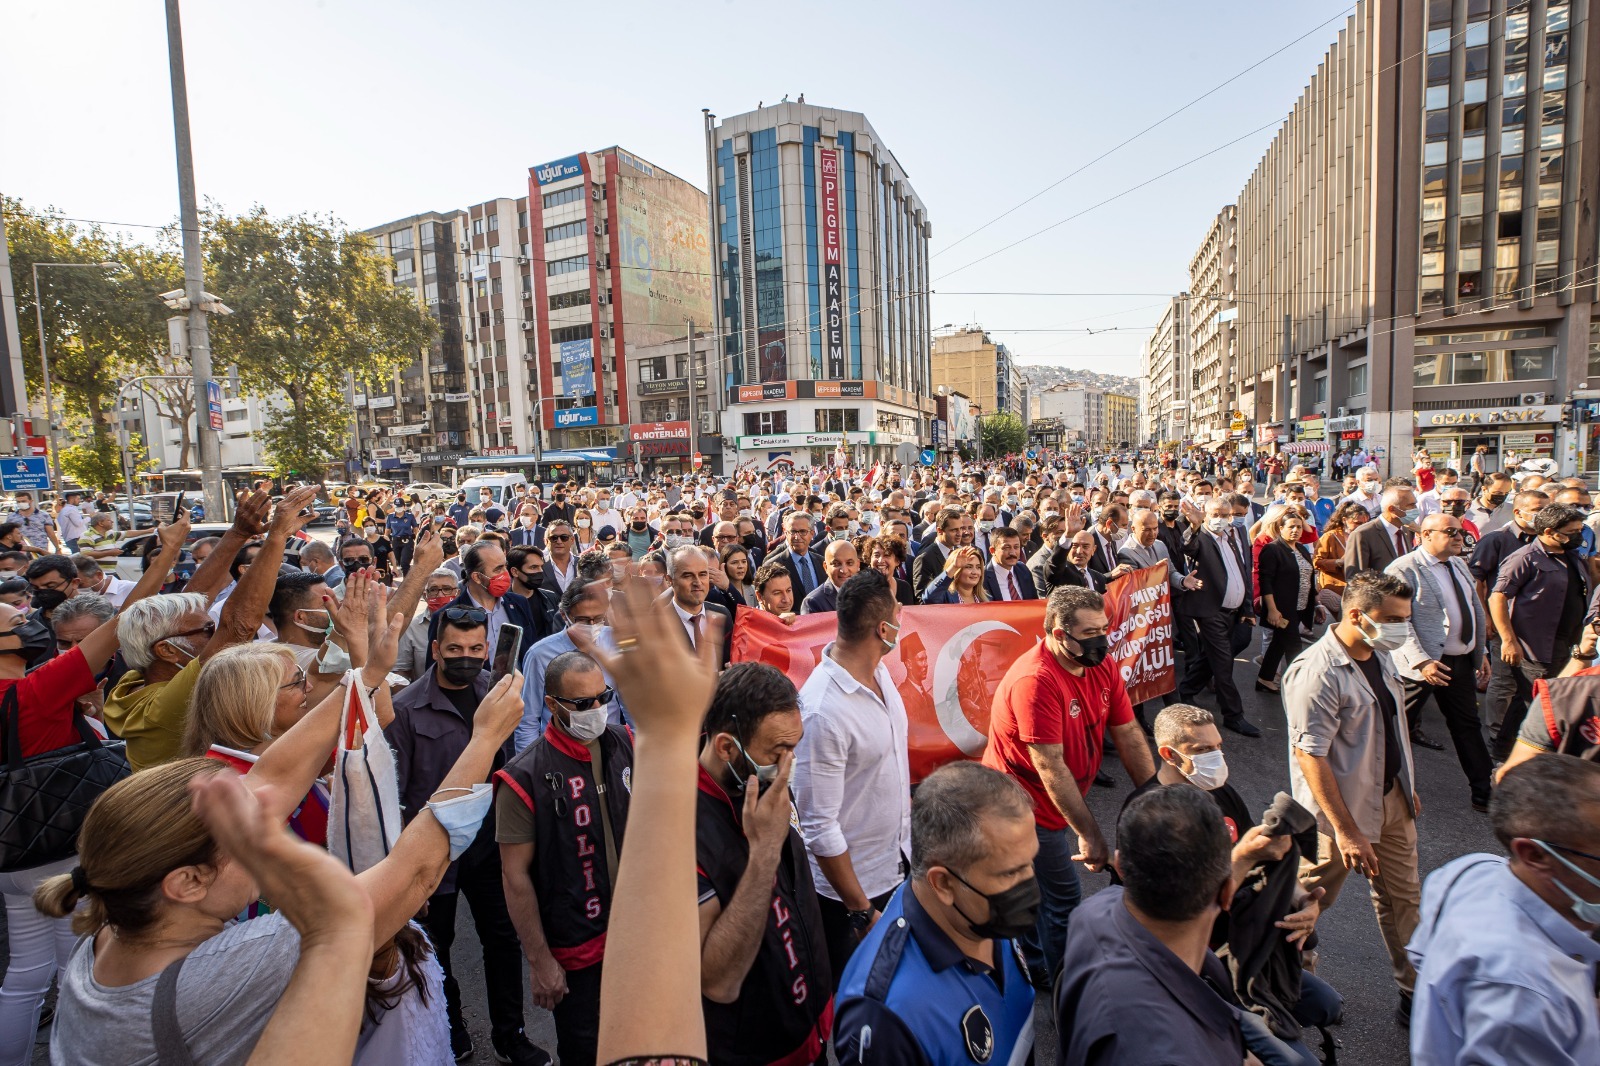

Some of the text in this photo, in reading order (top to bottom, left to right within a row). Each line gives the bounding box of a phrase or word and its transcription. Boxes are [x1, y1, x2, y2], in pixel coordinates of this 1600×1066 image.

[538, 164, 579, 182] uğur kurs
[826, 181, 839, 261] PEGEM
[829, 266, 842, 377] AKADEMİ
[559, 410, 580, 425] uğur
[633, 427, 688, 440] 6. NOTERLİĞİ
[1431, 408, 1546, 425] ODAK DÖVİZ
[568, 776, 601, 919] POLİS
[772, 873, 808, 1006] LİS
